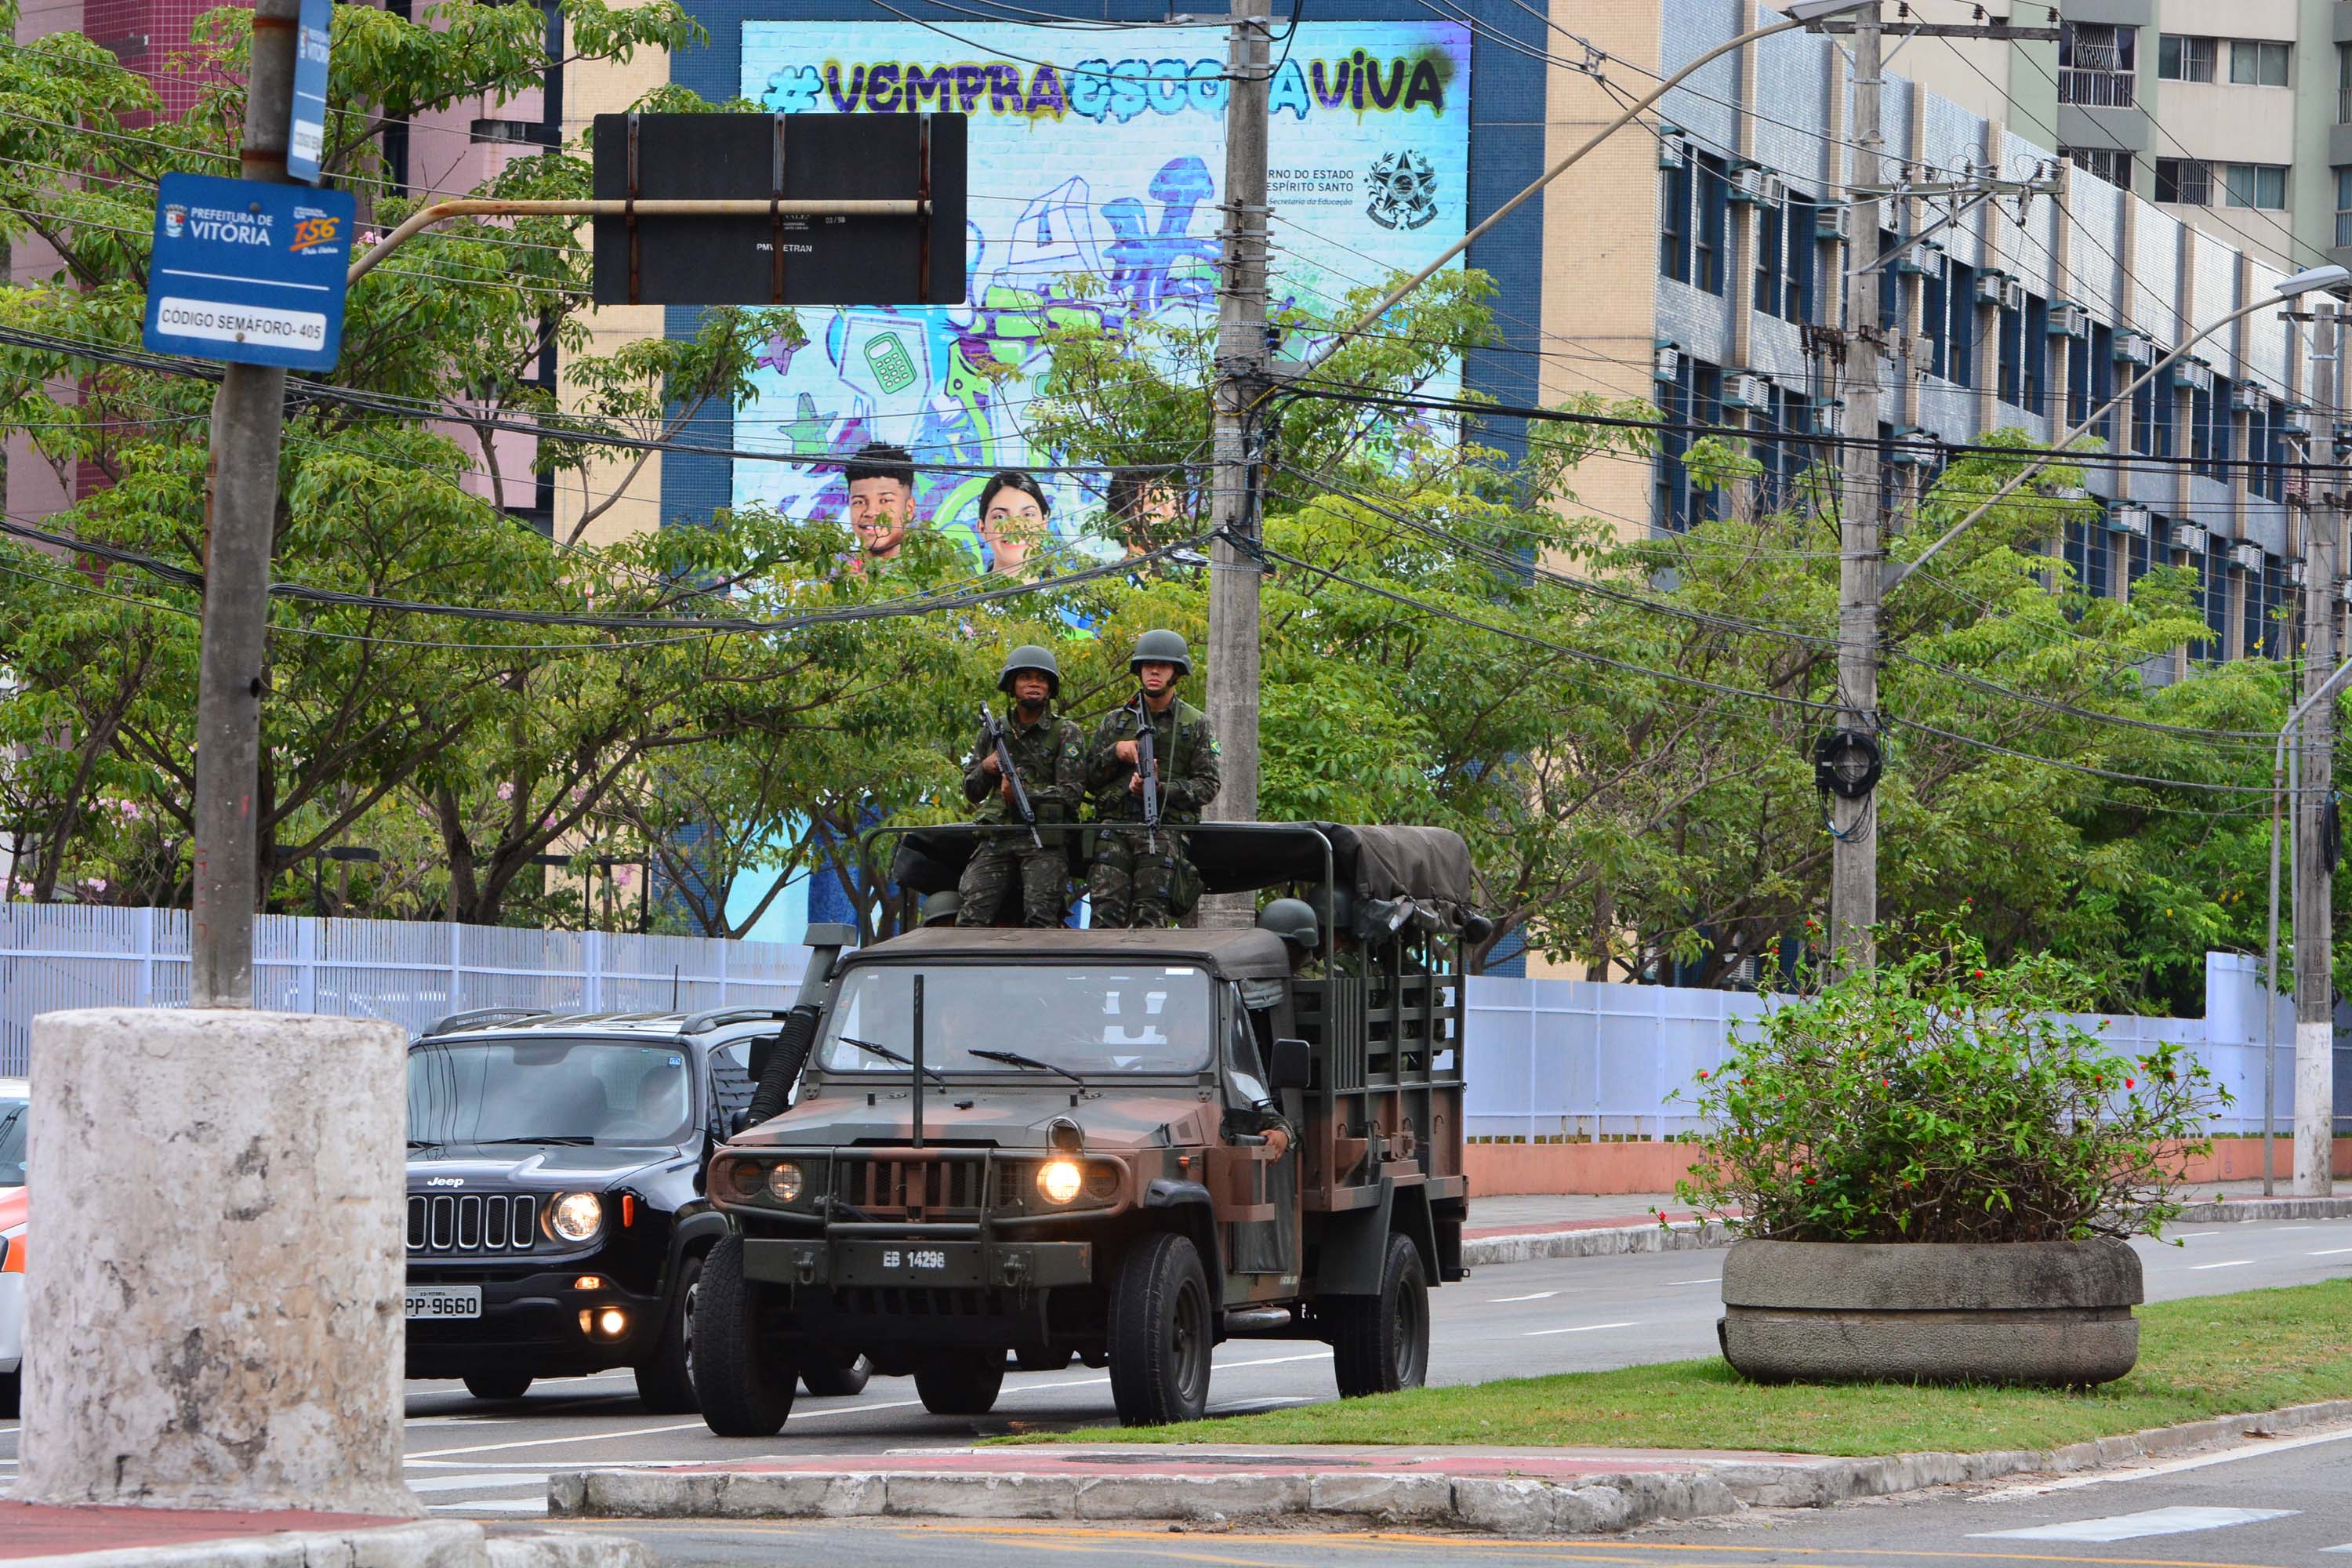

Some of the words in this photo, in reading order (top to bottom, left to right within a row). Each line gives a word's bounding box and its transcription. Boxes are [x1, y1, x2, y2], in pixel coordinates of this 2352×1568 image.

[1294, 169, 1309, 180] DO
[1313, 169, 1354, 180] ESTADO
[1318, 182, 1354, 191] SANTO
[191, 207, 255, 225] PREFEITURA
[257, 214, 274, 227] DE
[190, 220, 270, 247] VITÓRIA
[293, 216, 340, 244] 156
[162, 307, 215, 328] CÓDIGO
[299, 324, 321, 339] 405
[426, 1177, 465, 1189] Jeep
[883, 1250, 901, 1268] EB
